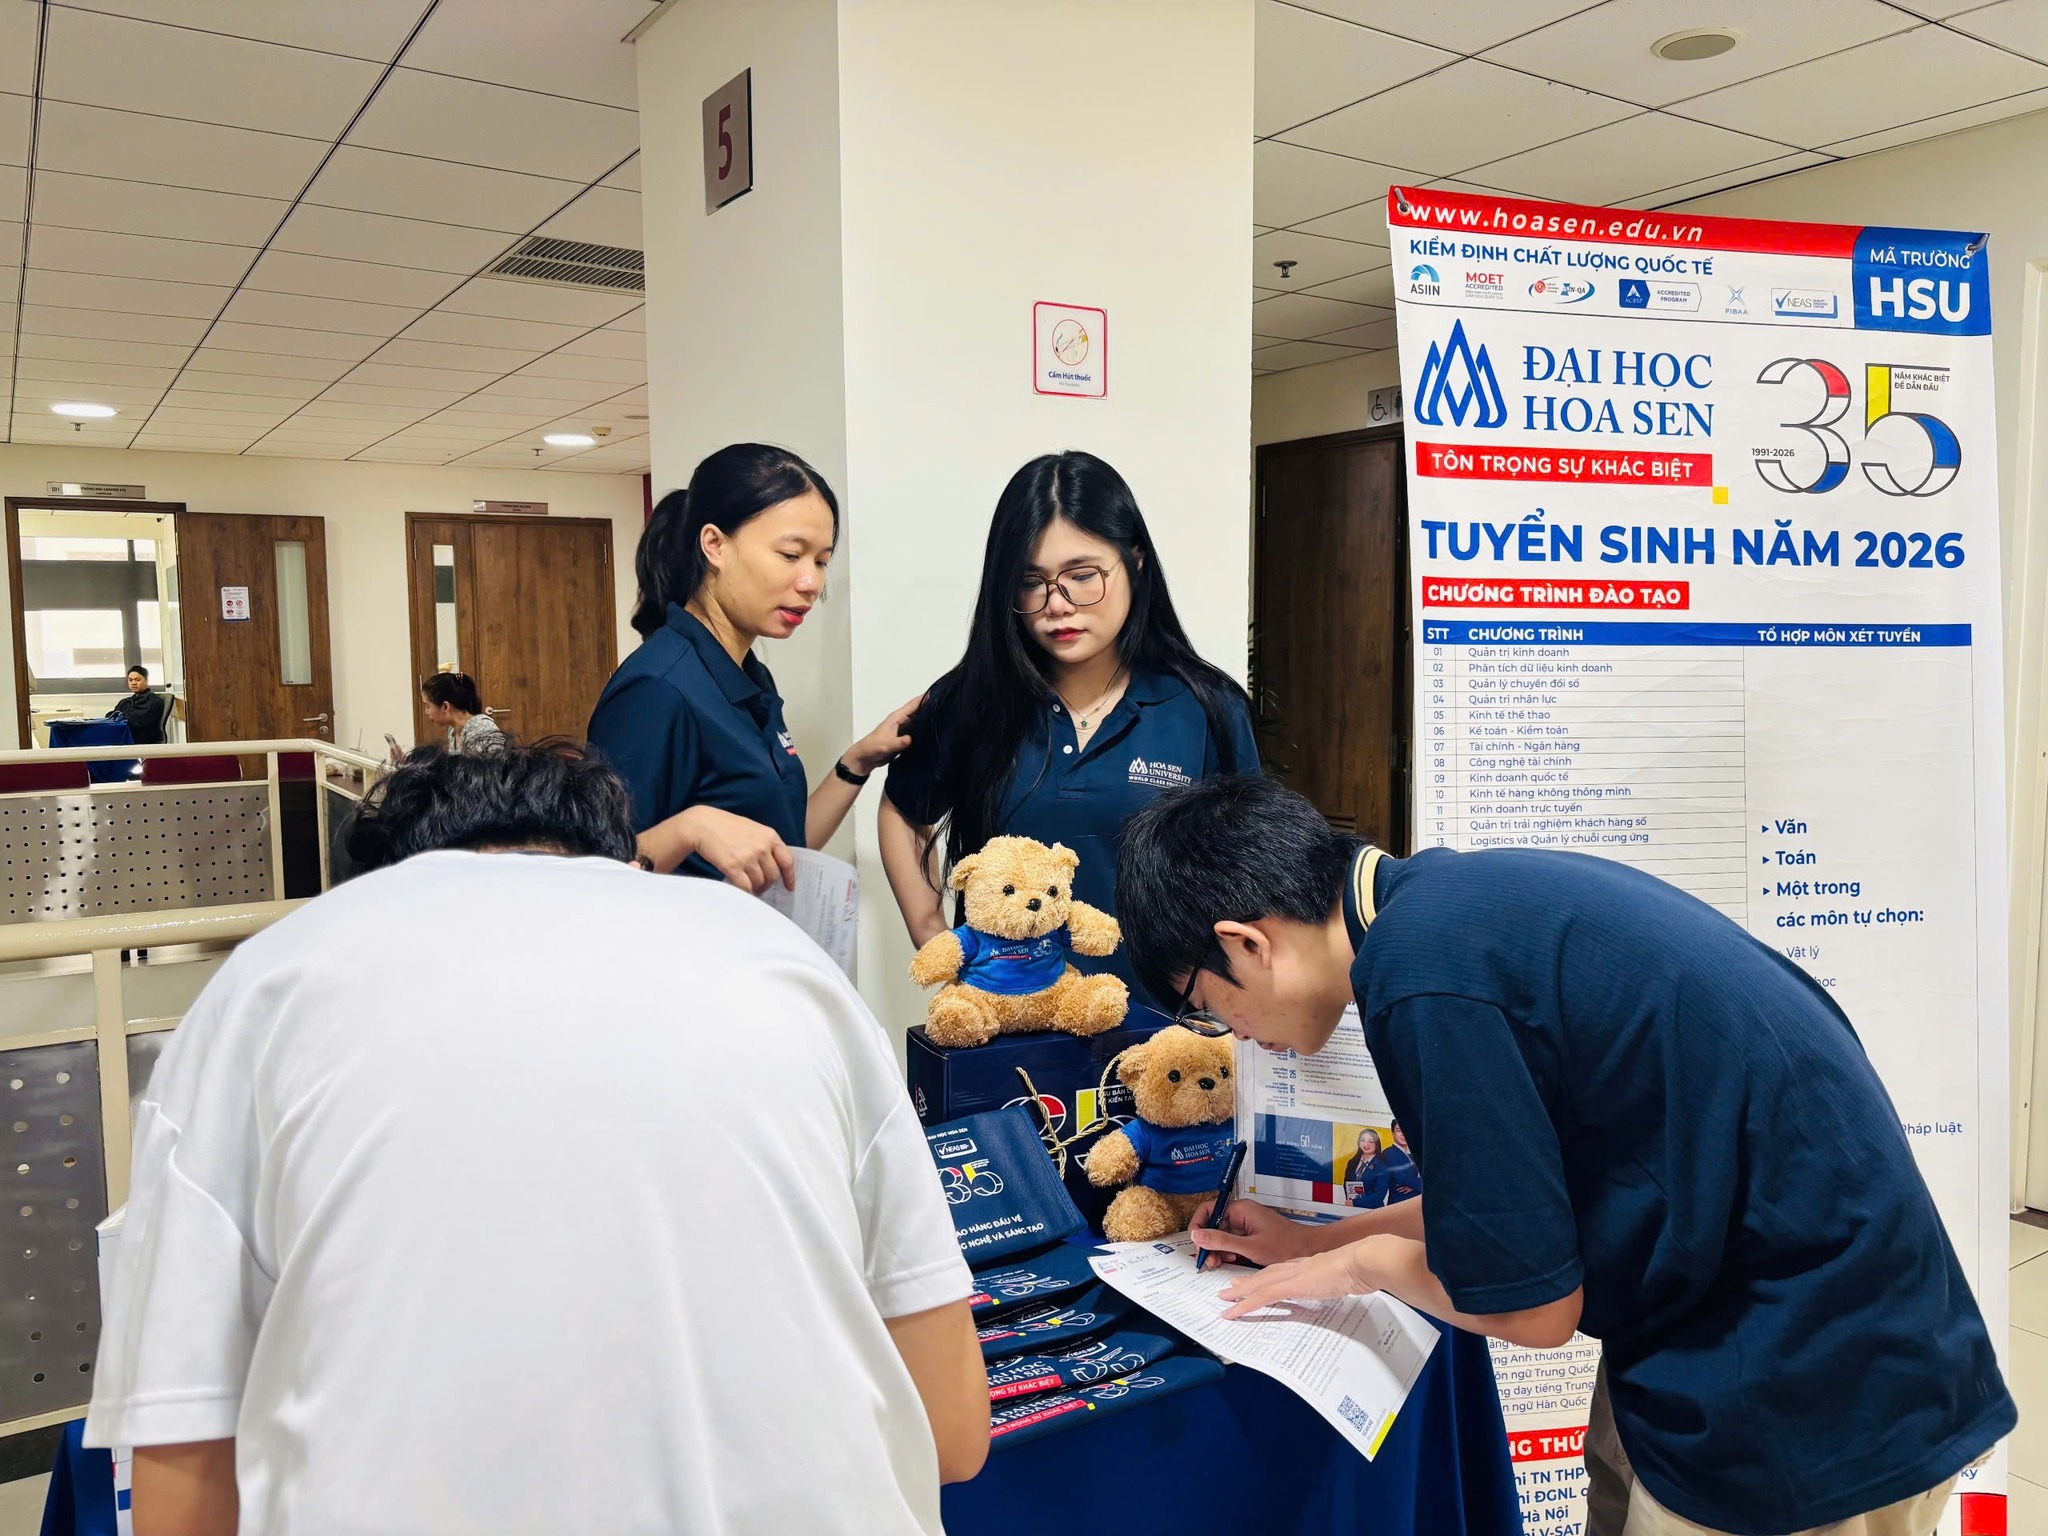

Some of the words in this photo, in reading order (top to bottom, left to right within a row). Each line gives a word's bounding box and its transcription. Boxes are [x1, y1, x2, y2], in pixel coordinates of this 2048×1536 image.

[718, 104, 732, 180] 5
[1409, 204, 1704, 242] www.hoasen.edu.vn
[1410, 236, 1455, 257] KIỂM
[1461, 244, 1508, 263] ĐỊNH
[1514, 246, 1562, 265] CHẤT
[1568, 251, 1629, 272] LƯỢNG
[1634, 254, 1686, 275] QUỐC
[1692, 257, 1714, 275] TẾ
[1870, 248, 1896, 264] MÃ
[1902, 250, 1971, 269] TRƯỜNG
[1466, 272, 1504, 284] MOET
[1410, 284, 1440, 296] ASIIN
[1787, 296, 1812, 308] NEAS
[1870, 276, 1971, 322] HSU
[1522, 346, 1602, 387] ĐẠI
[1614, 350, 1713, 392] HỌC
[1074, 374, 1091, 382] thuốc
[1523, 395, 1624, 433] HOA
[1633, 400, 1714, 437] SEN
[1756, 357, 1962, 498] 35
[1752, 448, 1794, 457] 1991-2026
[1432, 450, 1474, 471] TÔN
[1480, 454, 1552, 477] TRỌNG
[1558, 456, 1586, 478] SỰ
[1592, 456, 1645, 477] KHÁC
[1652, 458, 1693, 481] BIỆT
[1421, 507, 1583, 563] TUYỂN
[1599, 525, 1714, 566] SINH
[1733, 519, 1838, 568] NĂM
[1854, 529, 1965, 569] 2026
[1427, 581, 1514, 603] CHƯƠNG
[1520, 580, 1583, 605] TRÌNH
[1589, 582, 1635, 605] ĐÀO
[1640, 587, 1681, 610] TẠO
[1427, 627, 1449, 640] STT
[1469, 627, 1534, 640] CHƯƠNG
[1538, 626, 1583, 641] TRÌNH
[1757, 625, 1777, 643] TỔ
[1780, 629, 1810, 645] HỢP
[1813, 626, 1846, 643] MÔN
[1850, 627, 1874, 643] XÉT
[1877, 627, 1921, 643] TUYỂN
[1434, 648, 1443, 656] 01
[1469, 647, 1496, 658] Quản
[1499, 649, 1510, 658] trị
[1513, 648, 1535, 657] kinh
[1538, 649, 1569, 657] doanh
[1433, 664, 1443, 672] 02
[1469, 664, 1495, 673] Phân
[1498, 664, 1517, 673] tích
[1520, 664, 1534, 673] dữ
[1536, 664, 1553, 673] liệu
[1557, 664, 1579, 672] kinh
[1582, 664, 1612, 673] doanh
[1149, 762, 1166, 770] HOA
[1168, 764, 1182, 773] SEN
[1149, 768, 1192, 784] UNIVERSITY
[1435, 790, 1444, 799] 10
[1470, 789, 1493, 798] Kinh
[1495, 789, 1505, 798] tế
[1508, 789, 1534, 799] hàng
[1537, 788, 1569, 798] không
[1573, 788, 1602, 797] thông
[1605, 787, 1631, 796] minh
[1437, 822, 1444, 830] 12
[1470, 820, 1497, 831] Quản
[1500, 821, 1511, 830] trị
[1533, 819, 1572, 830] nghiệm
[1575, 818, 1605, 827] khách
[1608, 818, 1633, 828] hàng
[1635, 816, 1646, 826] số
[1775, 819, 1807, 834] Văn
[1437, 838, 1444, 846] 13
[1471, 835, 1514, 847] Logistics
[1517, 836, 1528, 844] và
[1531, 834, 1558, 845] Quản
[1561, 834, 1569, 845] lý
[1572, 832, 1600, 843] chuỗi
[1602, 834, 1627, 844] cung
[1630, 832, 1648, 843] ứng
[1775, 850, 1816, 865] Toán
[1777, 881, 1809, 899] Một
[1814, 881, 1860, 897] trong
[1776, 912, 1805, 928] các
[1811, 910, 1848, 925] môn
[1853, 910, 1871, 927] tự
[1877, 908, 1924, 925] chọn:
[1786, 947, 1806, 961] Vật
[1810, 946, 1820, 959] lý
[1936, 1122, 1962, 1135] luật
[970, 1222, 993, 1234] HÀNG
[993, 1217, 1011, 1228] ĐẦU
[968, 1234, 992, 1248] NGHỆ
[993, 1231, 1005, 1240] VÀ
[1005, 1228, 1026, 1239] SÁNG
[1027, 1223, 1044, 1233] TẠO
[1510, 1353, 1532, 1363] Anh
[1535, 1351, 1573, 1361] thương
[1575, 1347, 1594, 1358] mại
[1512, 1369, 1532, 1381] ngữ
[1535, 1367, 1565, 1378] Trung
[1568, 1363, 1595, 1376] Quốc
[1514, 1386, 1532, 1396] dạy
[1535, 1383, 1562, 1393] tiếng
[1565, 1380, 1594, 1391] Trung
[1512, 1401, 1533, 1412] ngữ
[1536, 1400, 1557, 1409] Hàn
[1560, 1396, 1587, 1408] Quốc
[1539, 1430, 1585, 1454] THỨ
[1530, 1471, 1551, 1484] TN
[1534, 1487, 1576, 1503] ĐGNL
[1521, 1510, 1540, 1522] Hà
[1545, 1505, 1568, 1521] Nội
